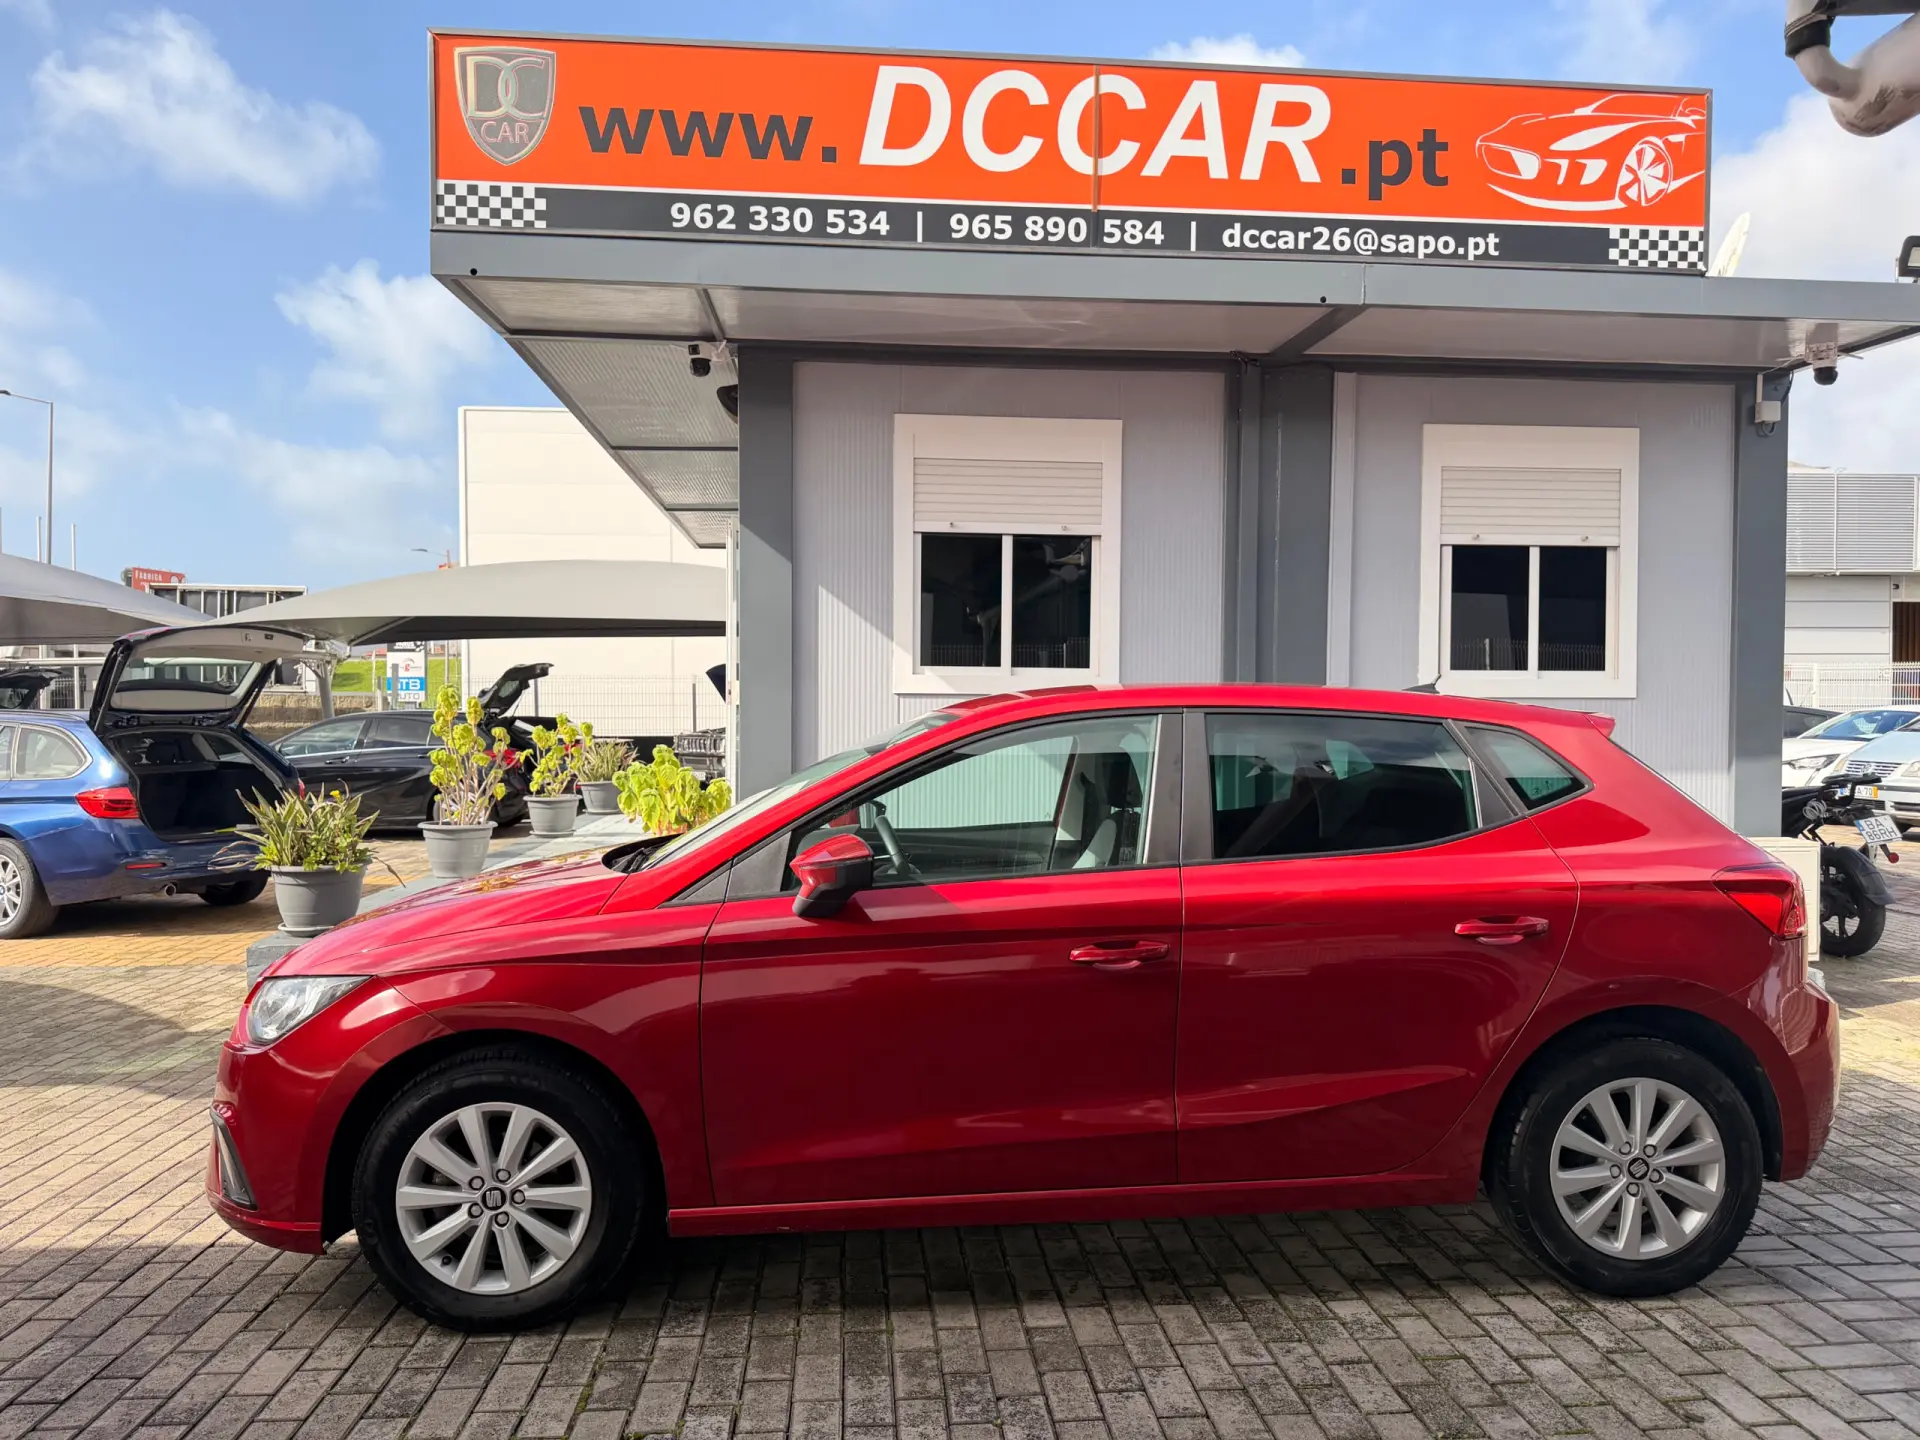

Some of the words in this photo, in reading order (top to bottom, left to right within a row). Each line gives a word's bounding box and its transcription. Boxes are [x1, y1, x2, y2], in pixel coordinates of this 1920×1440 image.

[480, 121, 530, 143] CAR
[670, 203, 737, 230] 962
[748, 206, 814, 233] 330
[826, 209, 891, 236] 534
[949, 213, 1013, 240] 965
[1024, 216, 1088, 243] 890
[1102, 219, 1165, 245] 584
[1221, 223, 1500, 262] dccar26@sapo.pt
[398, 679, 420, 690] TB
[1865, 818, 1884, 830] BA
